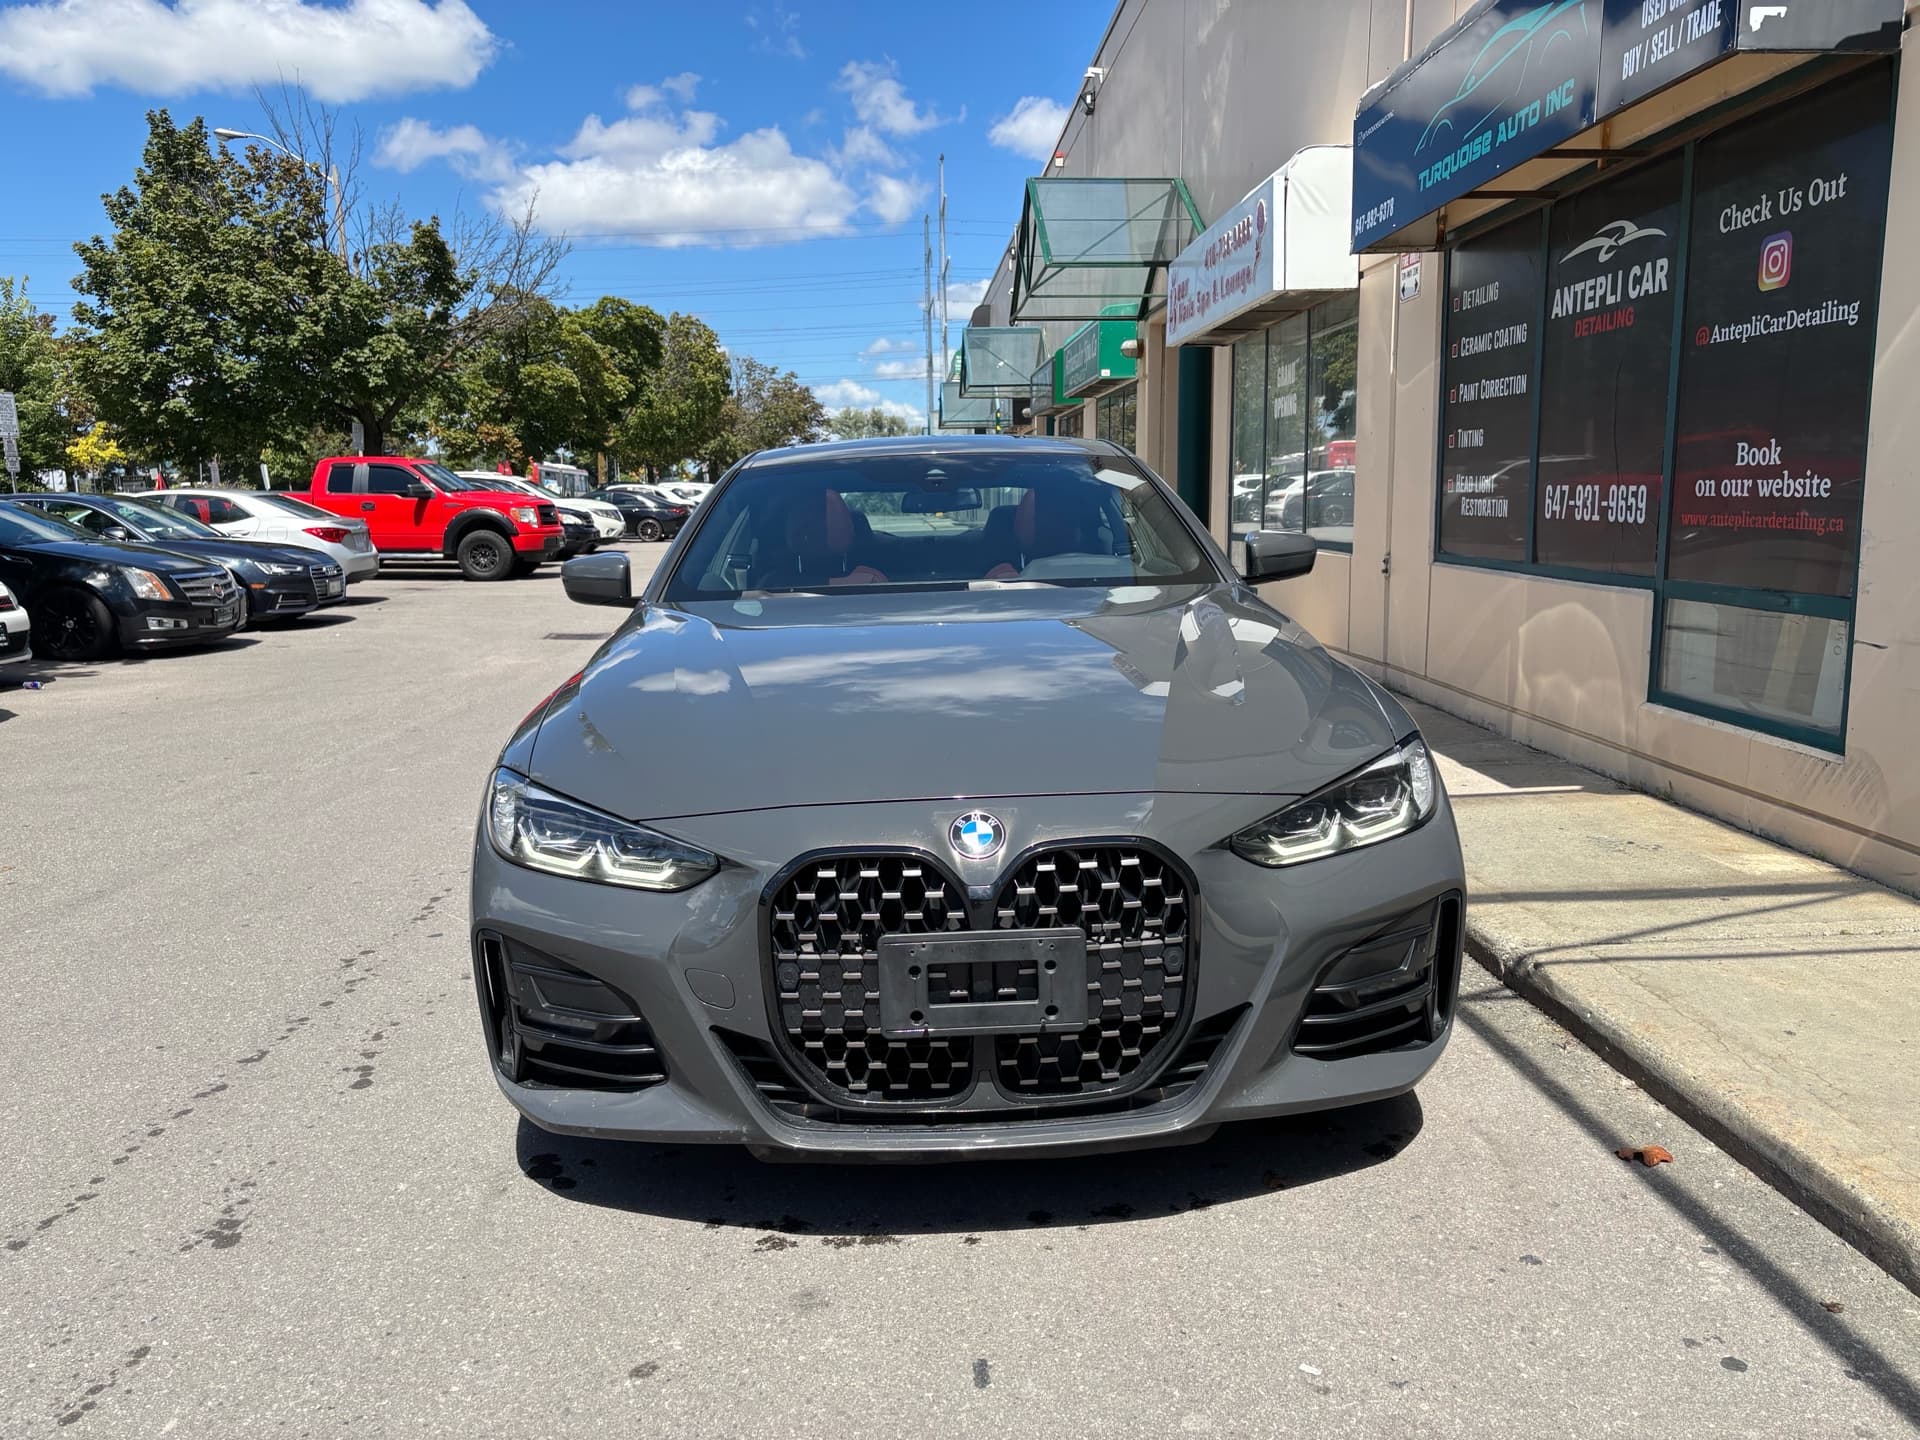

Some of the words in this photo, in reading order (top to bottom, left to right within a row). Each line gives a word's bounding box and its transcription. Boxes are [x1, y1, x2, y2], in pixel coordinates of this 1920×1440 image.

[1641, 0, 1667, 29] USED
[1622, 43, 1642, 80] BUY
[1650, 23, 1675, 64] SELL
[1686, 0, 1722, 44] TRADE
[1418, 129, 1492, 192] TURQUOISE
[1495, 99, 1541, 148] AUTO
[1545, 78, 1575, 118] INC
[1719, 194, 1772, 234] Check
[1778, 186, 1803, 216] Us
[1808, 172, 1848, 207] Out
[1220, 265, 1252, 295] Lounge
[1551, 269, 1623, 319] ANTEPLI
[1628, 257, 1669, 300] CAR
[1462, 281, 1500, 311] DETAILING
[1574, 304, 1635, 338] DETAILING
[1695, 300, 1860, 346] @AntepliCarDetailing
[1460, 332, 1493, 357] CERAMIC
[1493, 323, 1528, 349] COATING
[1458, 382, 1480, 403] PAINT
[1480, 374, 1528, 400] CORRECTION
[1457, 428, 1484, 449] TINTING
[1735, 438, 1782, 467] Book
[1695, 478, 1716, 497] on
[1720, 478, 1753, 498] our
[1756, 469, 1832, 498] website
[1460, 496, 1509, 518] RESTORATION
[1544, 484, 1647, 525] 647-931-9659
[1681, 510, 1844, 537] www.anteplicardetailing.ca
